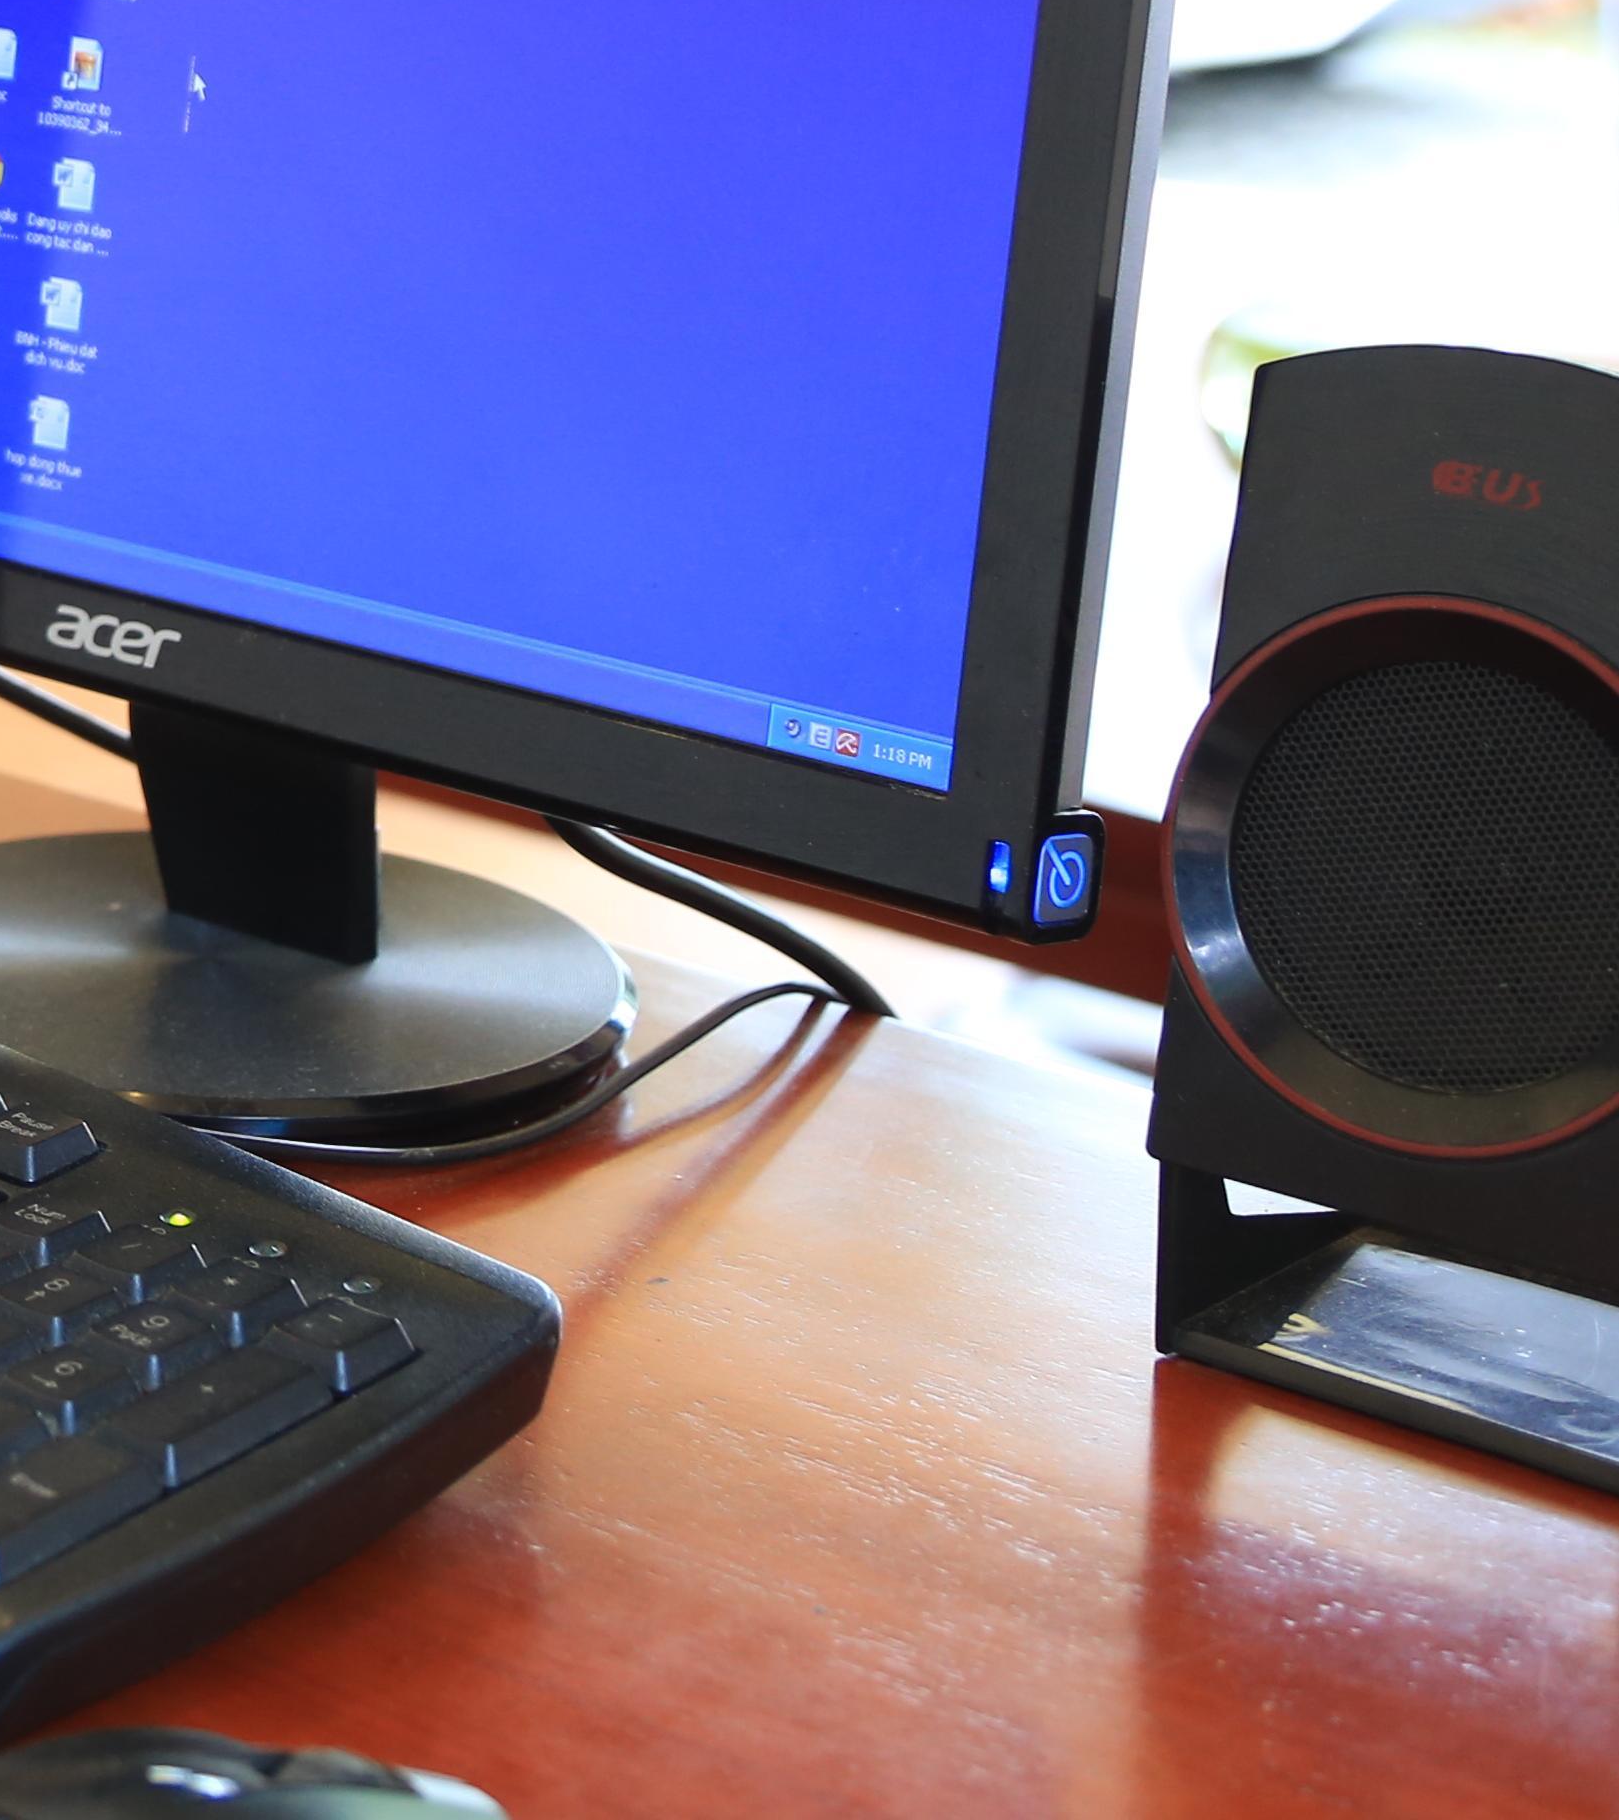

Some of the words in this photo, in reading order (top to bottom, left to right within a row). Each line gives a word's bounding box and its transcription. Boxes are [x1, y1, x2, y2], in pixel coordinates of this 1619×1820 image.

[52, 95, 96, 115] Shortcut
[98, 102, 112, 116] to
[27, 212, 56, 232] Dang
[91, 222, 112, 239] dao
[26, 233, 52, 249] cong
[48, 337, 78, 355] Phieu
[80, 343, 98, 359] dat
[49, 356, 85, 374] vu.doc
[28, 454, 55, 474] dong
[46, 603, 182, 668] acer
[873, 743, 906, 764] 1:18
[908, 751, 932, 770] PM
[12, 1111, 55, 1131] Pause
[14, 1209, 52, 1225] Lock
[28, 1203, 66, 1220] Num
[44, 1278, 70, 1292] 8
[141, 1315, 170, 1330] 9
[54, 1360, 84, 1376] 6
